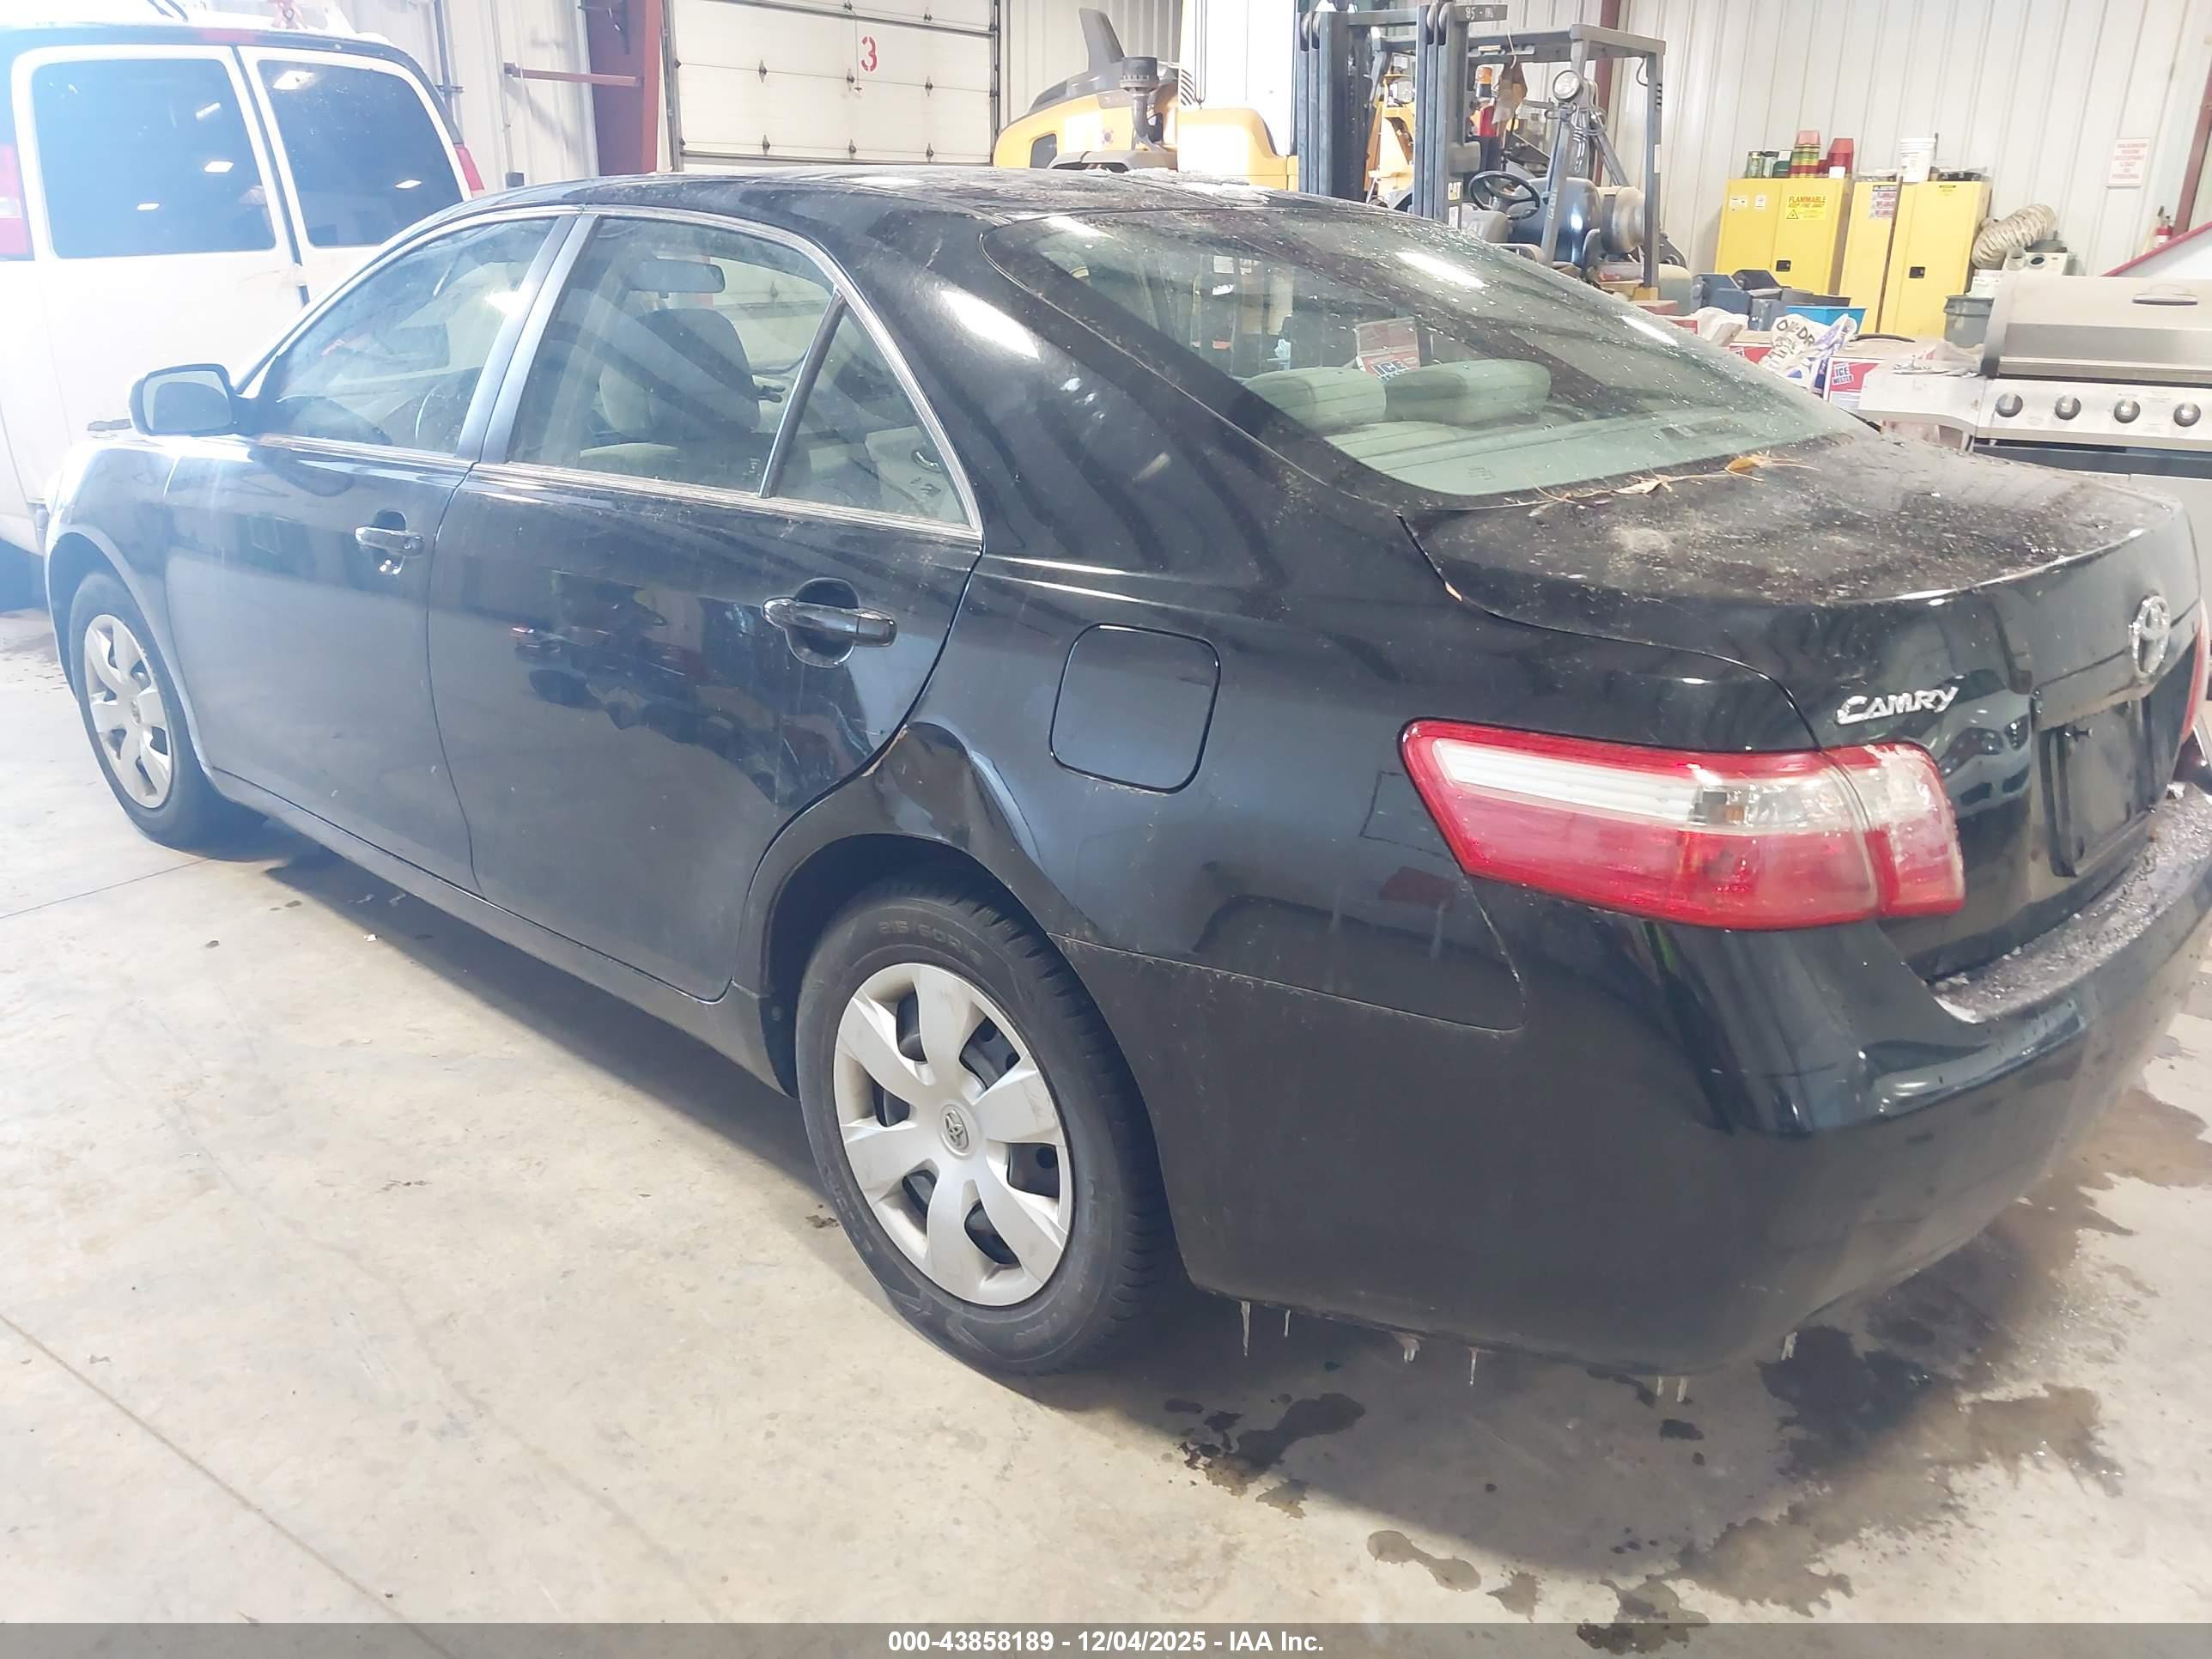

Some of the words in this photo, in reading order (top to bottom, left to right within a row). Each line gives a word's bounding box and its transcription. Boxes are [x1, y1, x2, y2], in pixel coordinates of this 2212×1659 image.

[861, 36, 878, 71] 3
[1448, 181, 1462, 201] CAT
[1835, 367, 1849, 376] ICE
[1837, 686, 1959, 725] CAMRY
